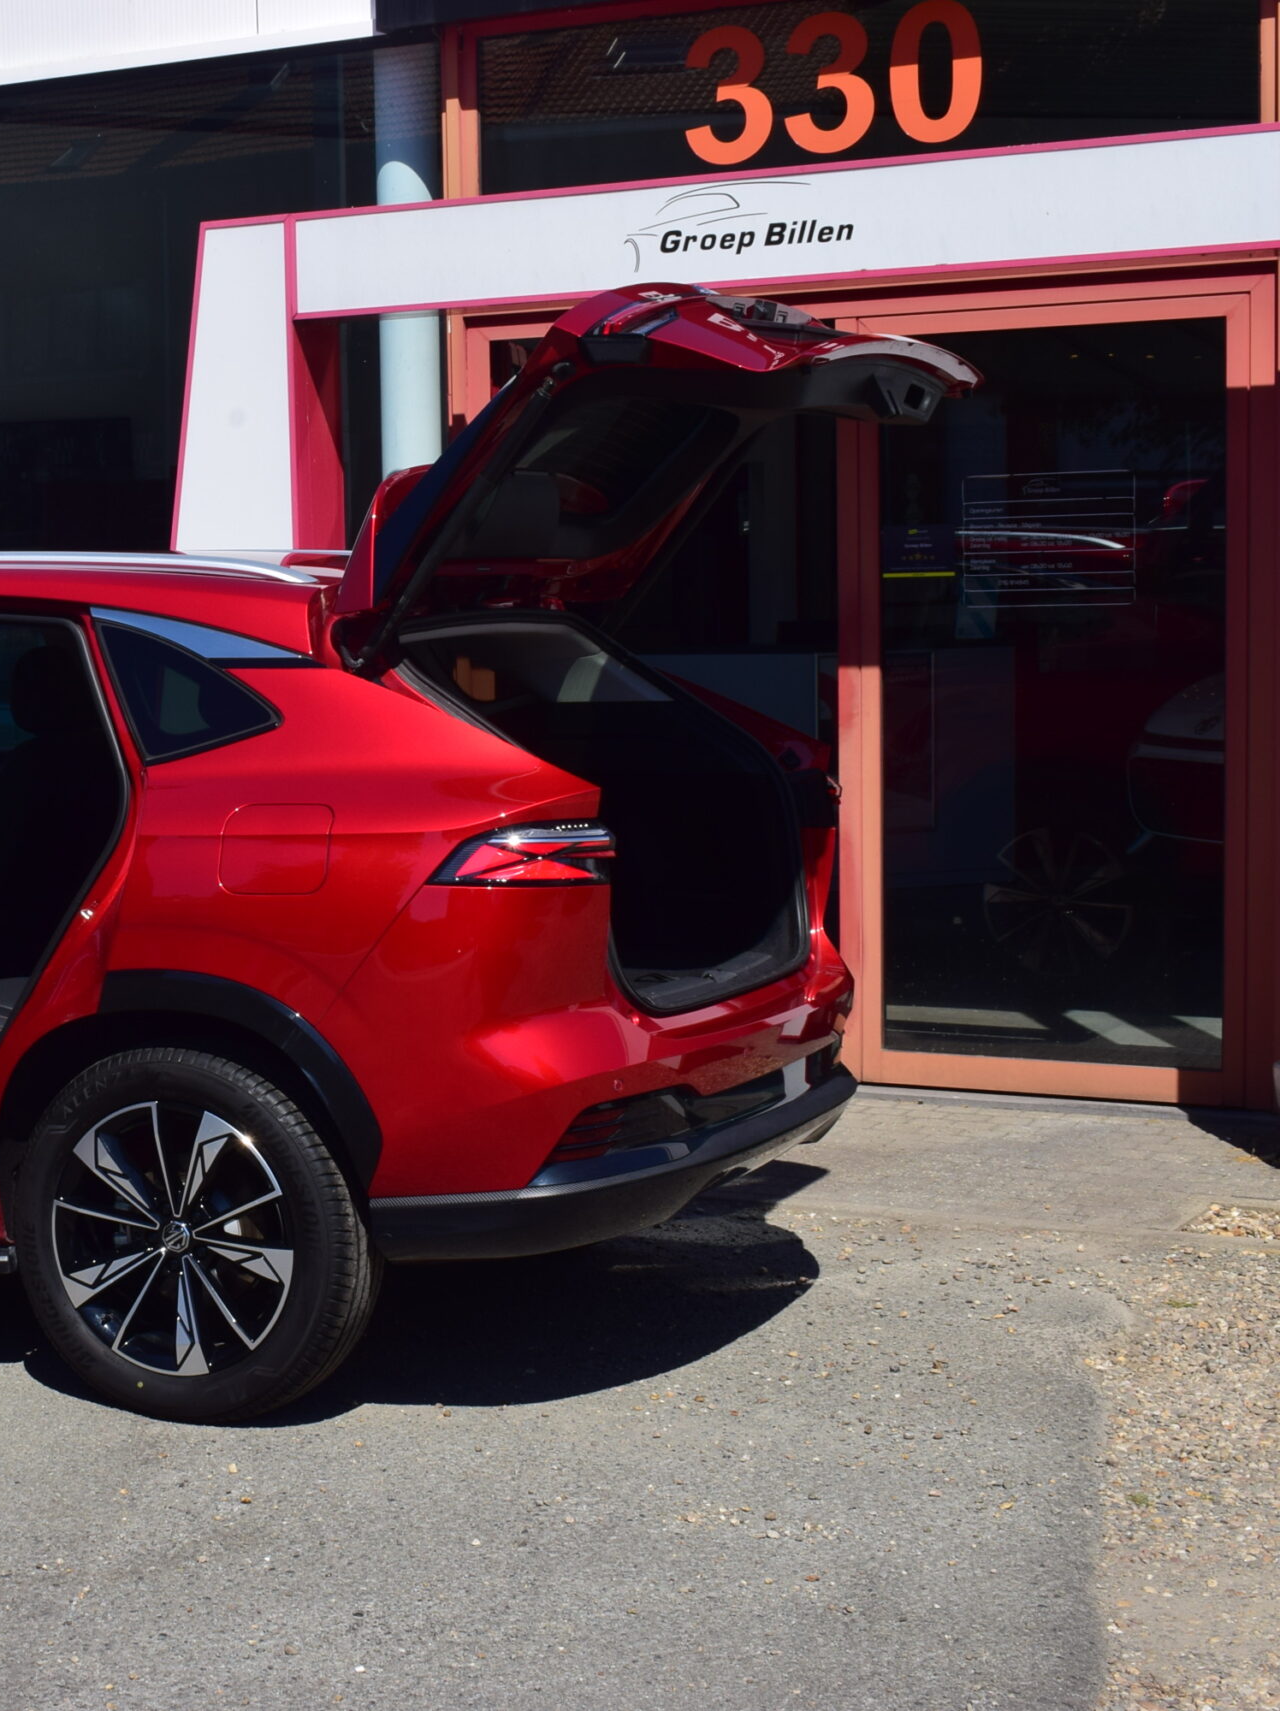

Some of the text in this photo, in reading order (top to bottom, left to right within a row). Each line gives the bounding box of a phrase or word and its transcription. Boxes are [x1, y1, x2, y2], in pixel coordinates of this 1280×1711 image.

[684, 0, 984, 166] 330
[660, 219, 854, 255] Groep Billen
